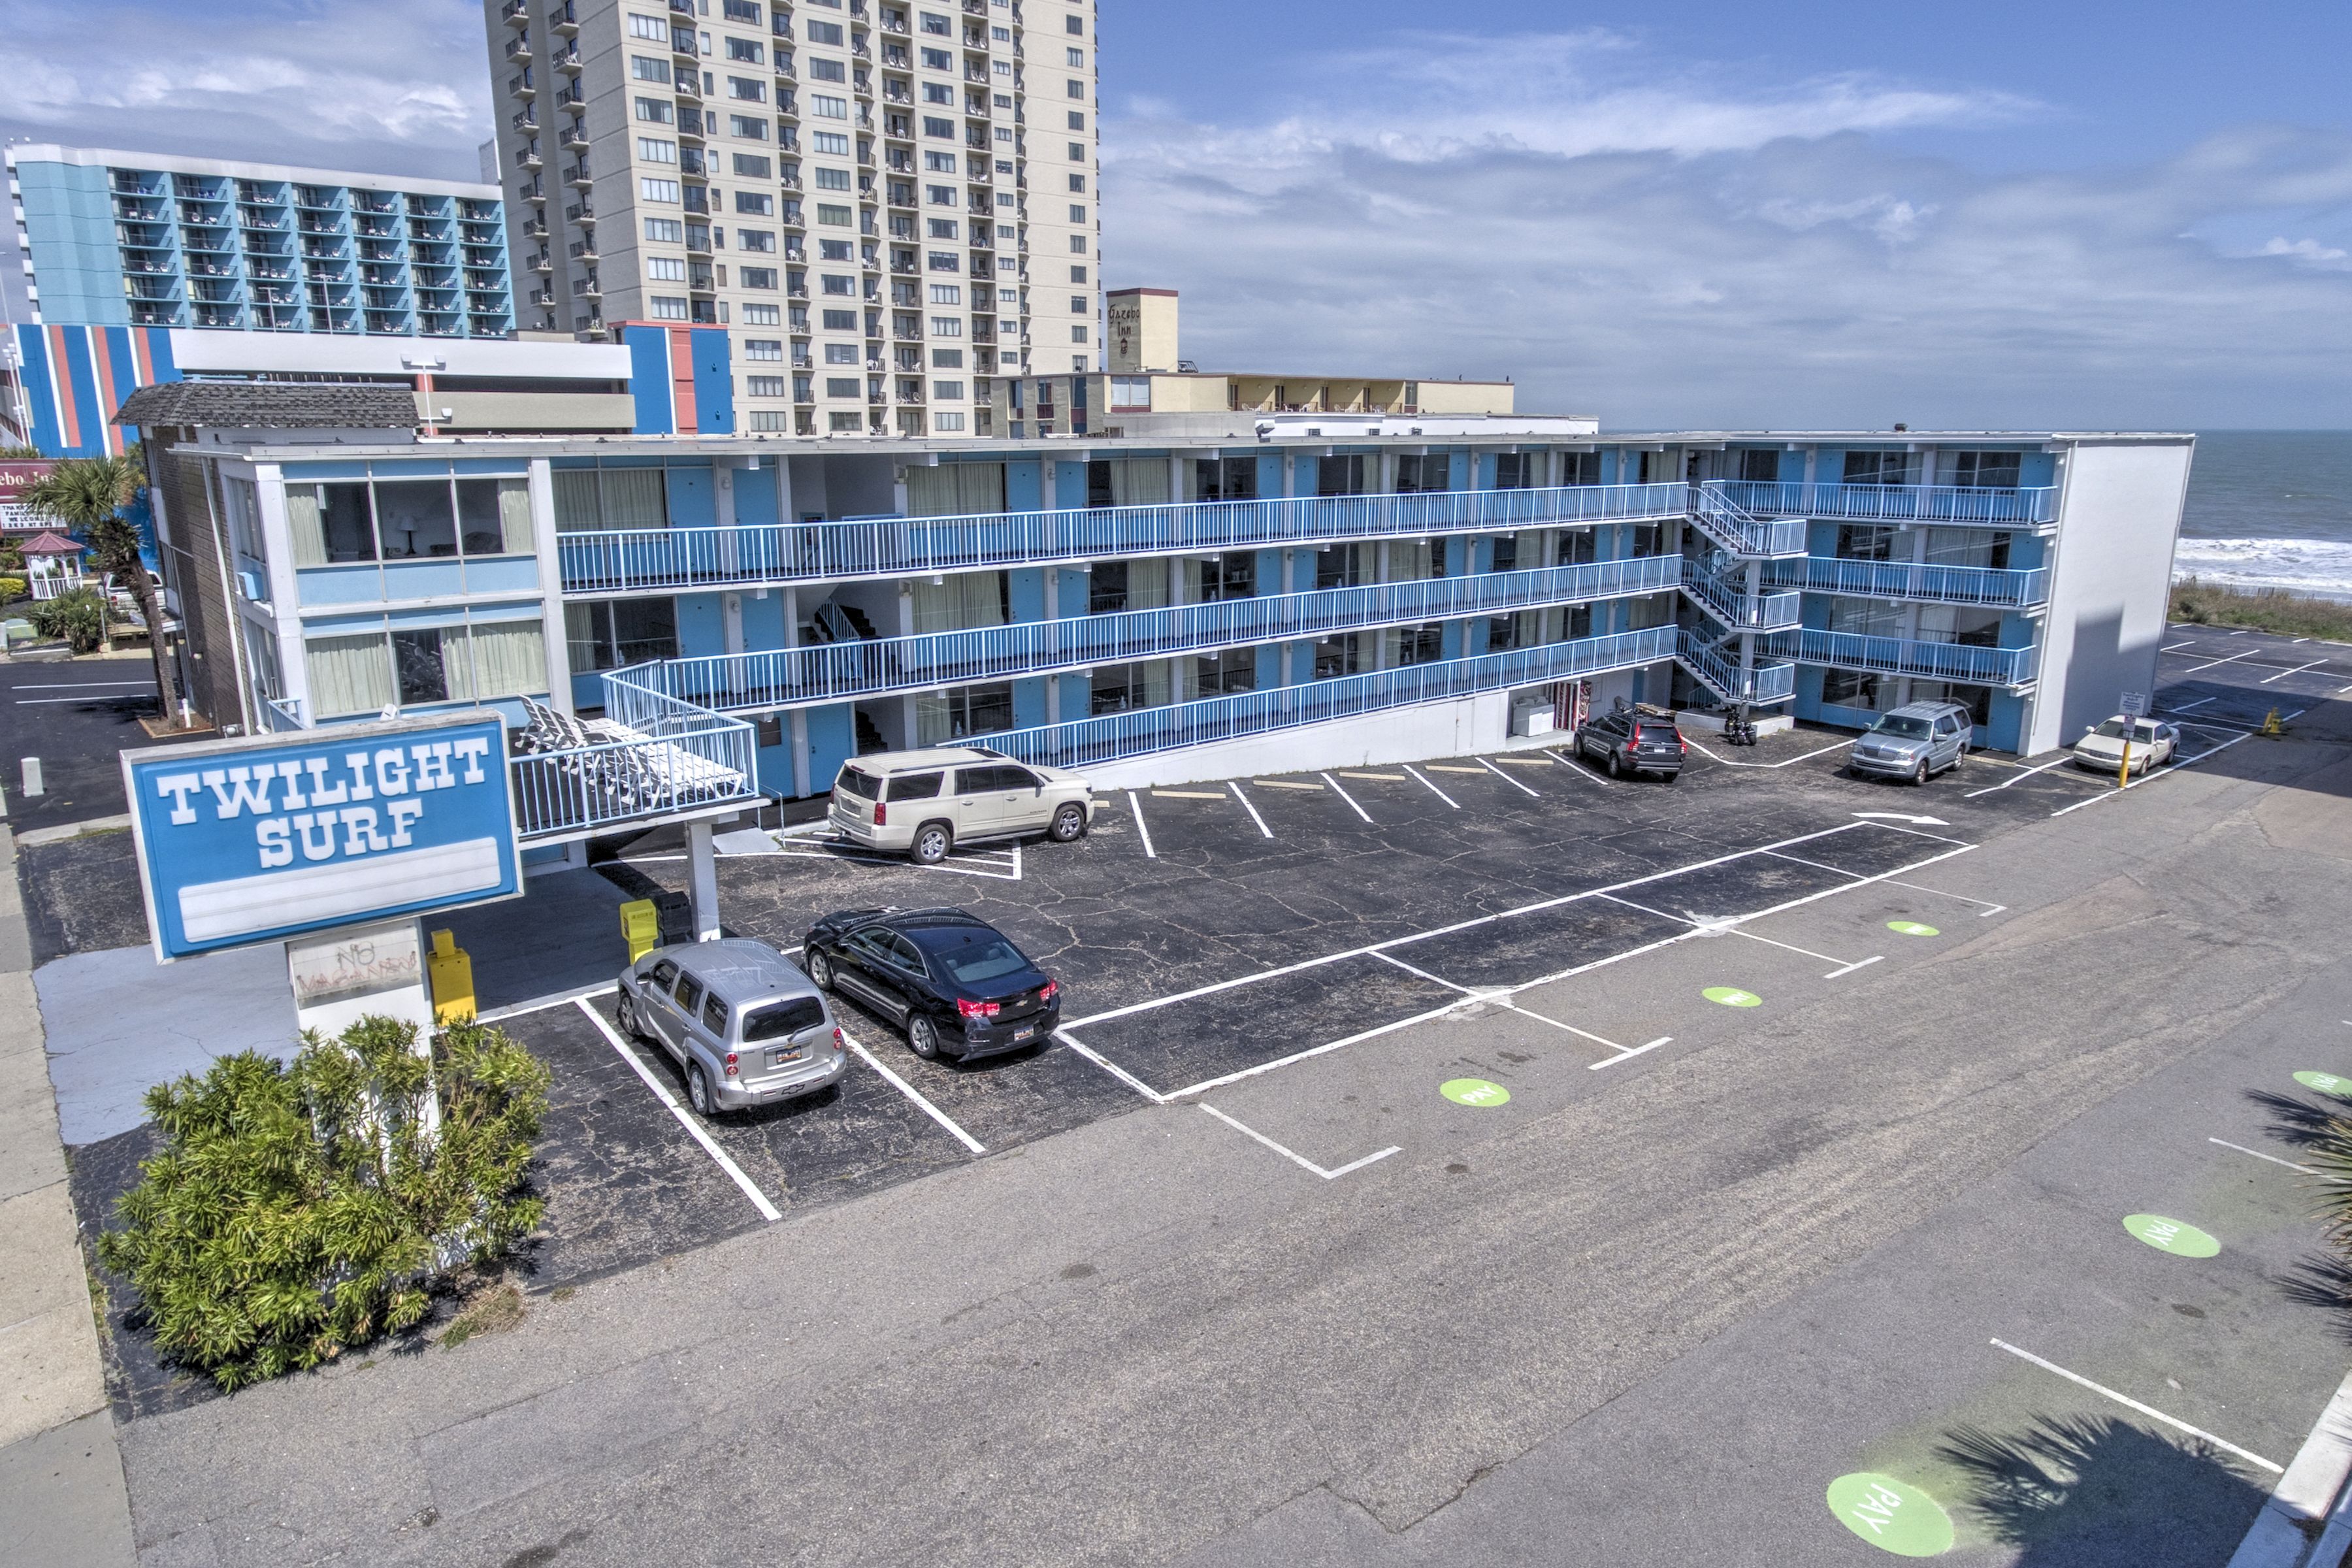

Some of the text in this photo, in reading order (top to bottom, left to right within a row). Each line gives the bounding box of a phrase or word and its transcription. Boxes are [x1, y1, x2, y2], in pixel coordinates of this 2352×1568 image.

[1108, 304, 1140, 324] Gazebo
[1117, 321, 1132, 336] Inn
[156, 737, 489, 826] TWILIGHT
[255, 798, 423, 869] SURF
[337, 941, 375, 970] NO
[1459, 1085, 1499, 1104] PAY
[2310, 1073, 2339, 1090] PAY
[2143, 1219, 2180, 1247] PAY
[1852, 1482, 1903, 1535] PAY
